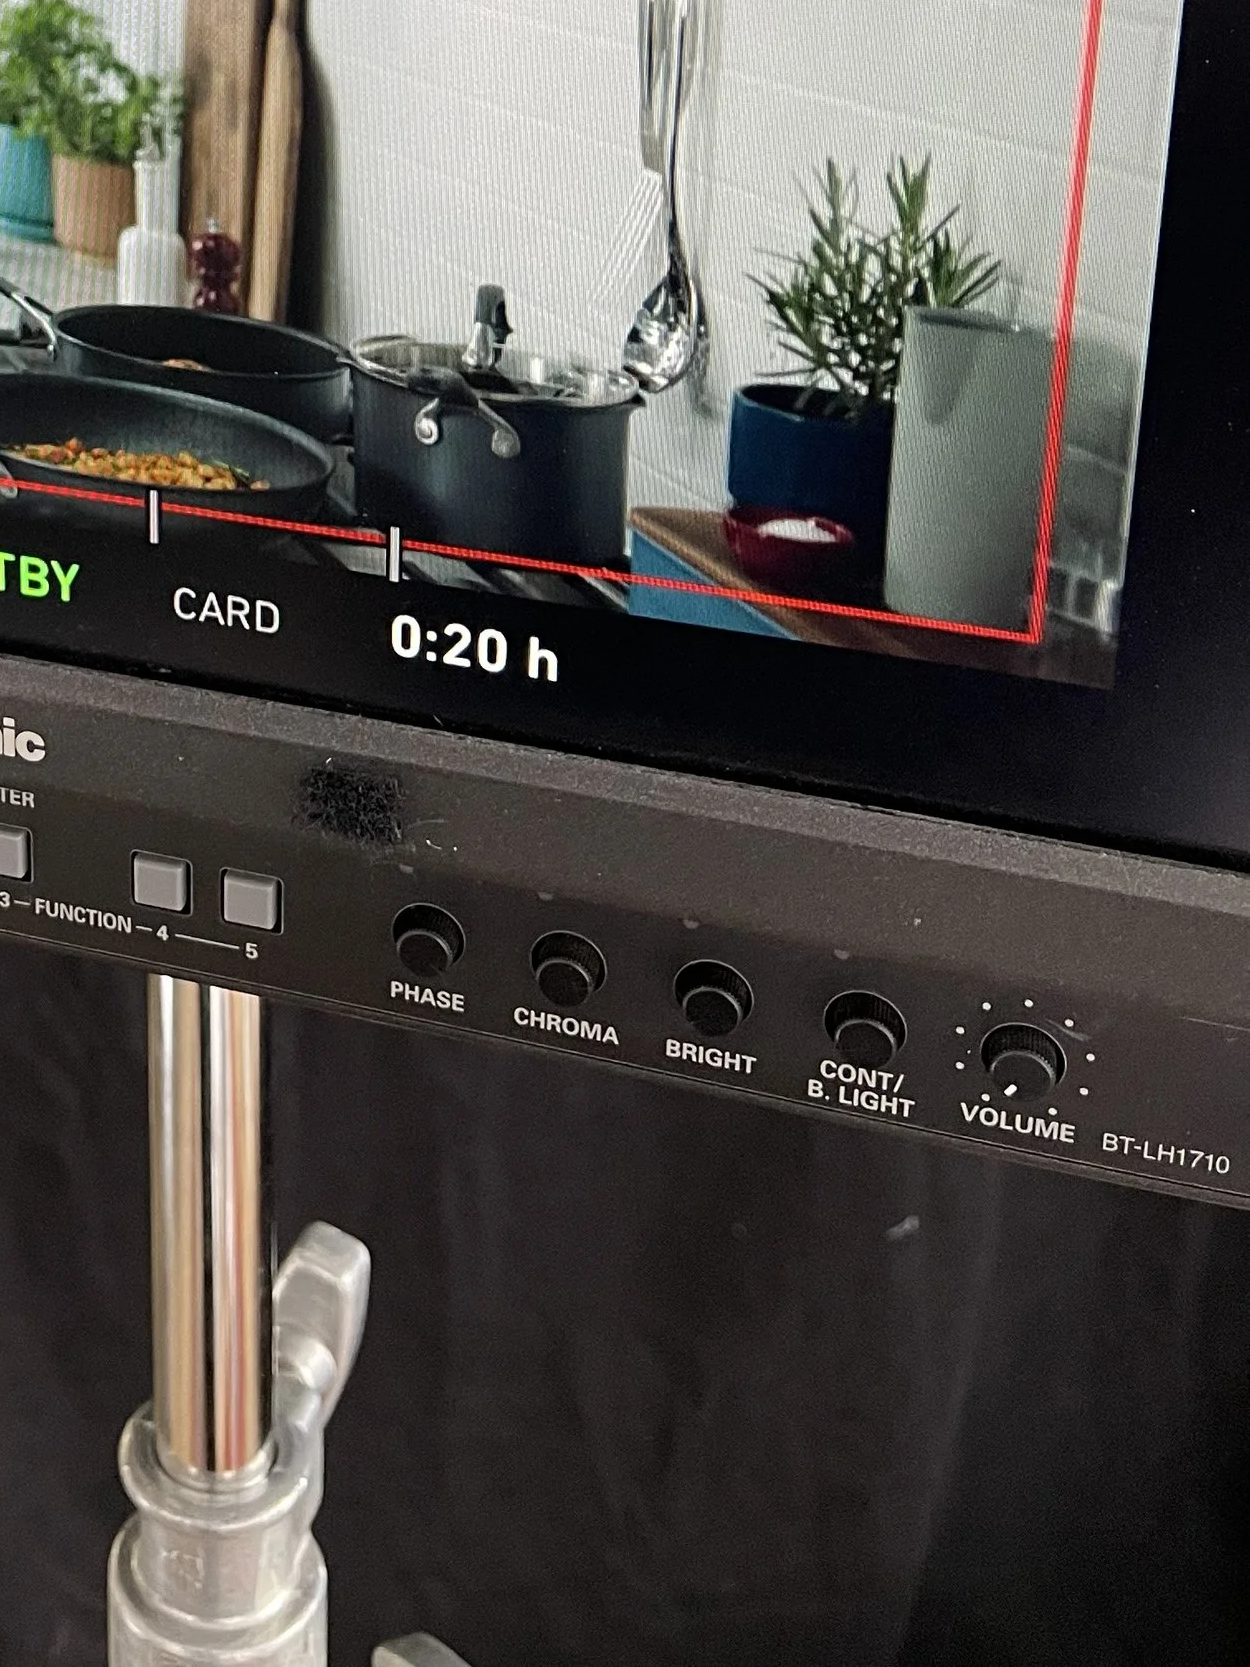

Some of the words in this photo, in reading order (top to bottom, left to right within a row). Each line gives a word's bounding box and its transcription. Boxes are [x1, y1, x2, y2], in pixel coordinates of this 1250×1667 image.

[173, 587, 281, 635] CARD
[390, 614, 508, 674] 0:20
[528, 636, 558, 682] h
[35, 897, 132, 934] FUNCTION
[156, 925, 169, 941] 4
[245, 943, 259, 960] 5
[390, 980, 465, 1012] PHASE
[513, 1006, 619, 1045] CHROMA
[665, 1038, 757, 1074] BRIGHT
[819, 1059, 906, 1093] CONT/
[807, 1079, 830, 1102] B.
[838, 1086, 915, 1118] LIGHT
[960, 1102, 1076, 1143] VOLUME
[1102, 1132, 1231, 1175] BT-LH1710
